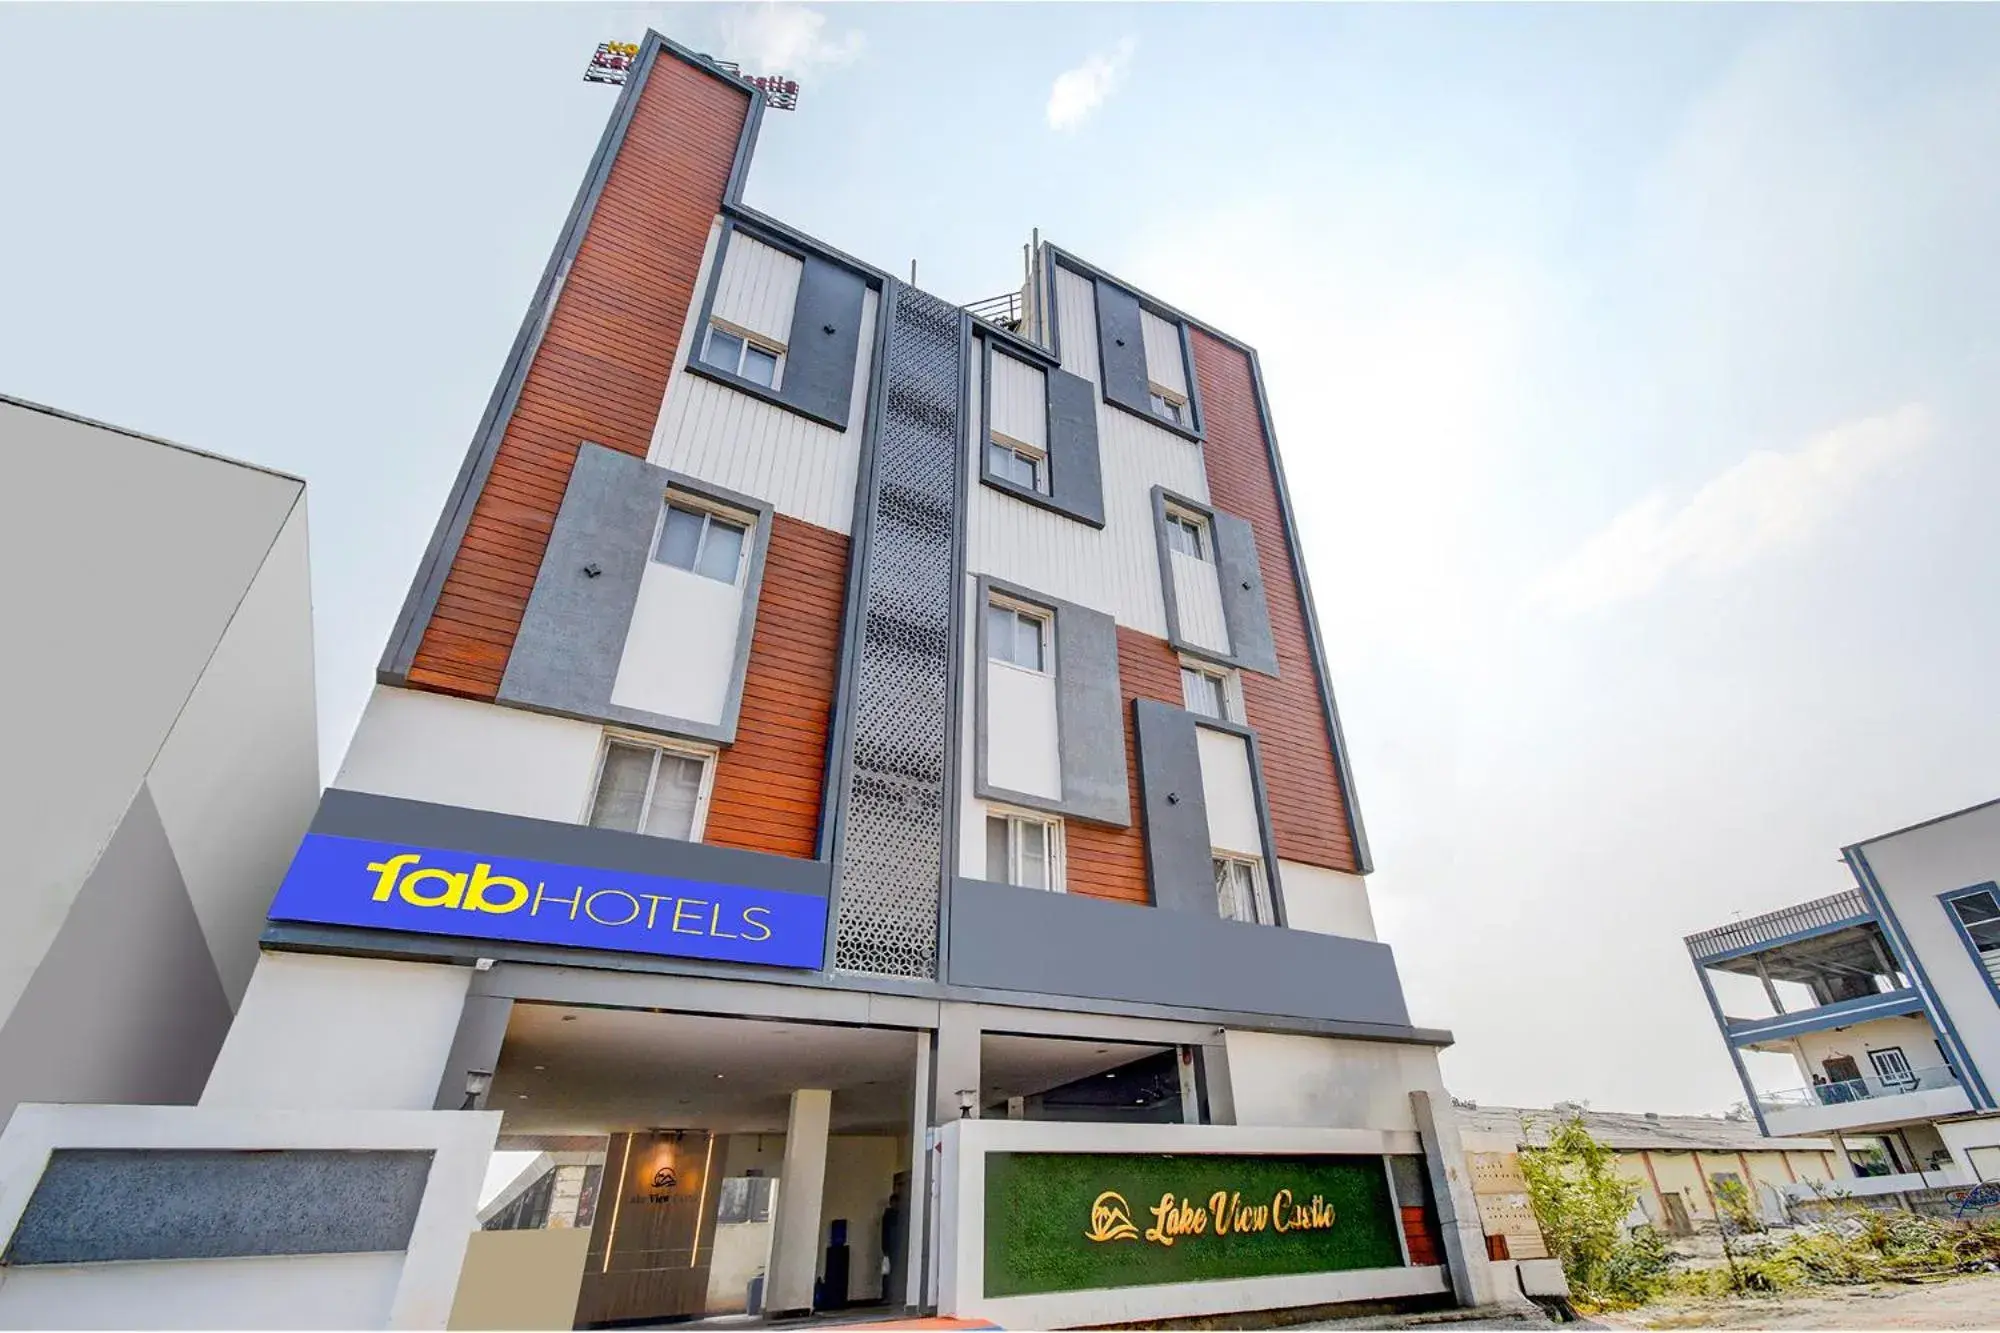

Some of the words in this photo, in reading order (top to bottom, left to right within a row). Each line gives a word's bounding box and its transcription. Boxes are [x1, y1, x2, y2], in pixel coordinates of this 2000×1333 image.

[366, 853, 772, 942] fabHOTELS
[1145, 1192, 1208, 1246] Lake
[1209, 1191, 1269, 1236] View
[1273, 1189, 1336, 1233] Castle
